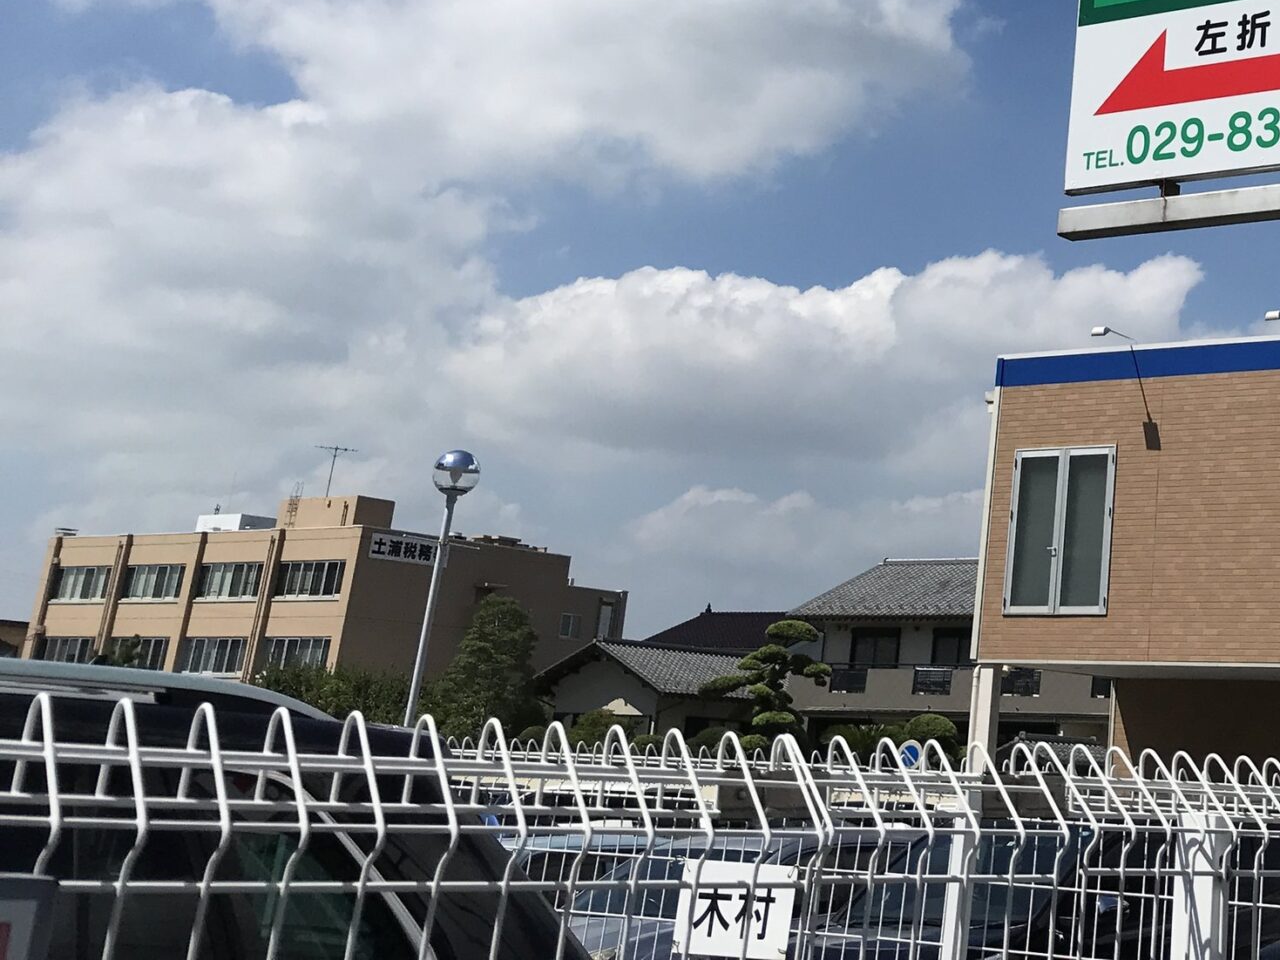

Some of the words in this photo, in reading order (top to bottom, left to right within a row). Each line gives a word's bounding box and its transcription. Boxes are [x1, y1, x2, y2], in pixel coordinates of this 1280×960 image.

[371, 537, 438, 562] 土浦税務
[692, 887, 776, 940] 木村
